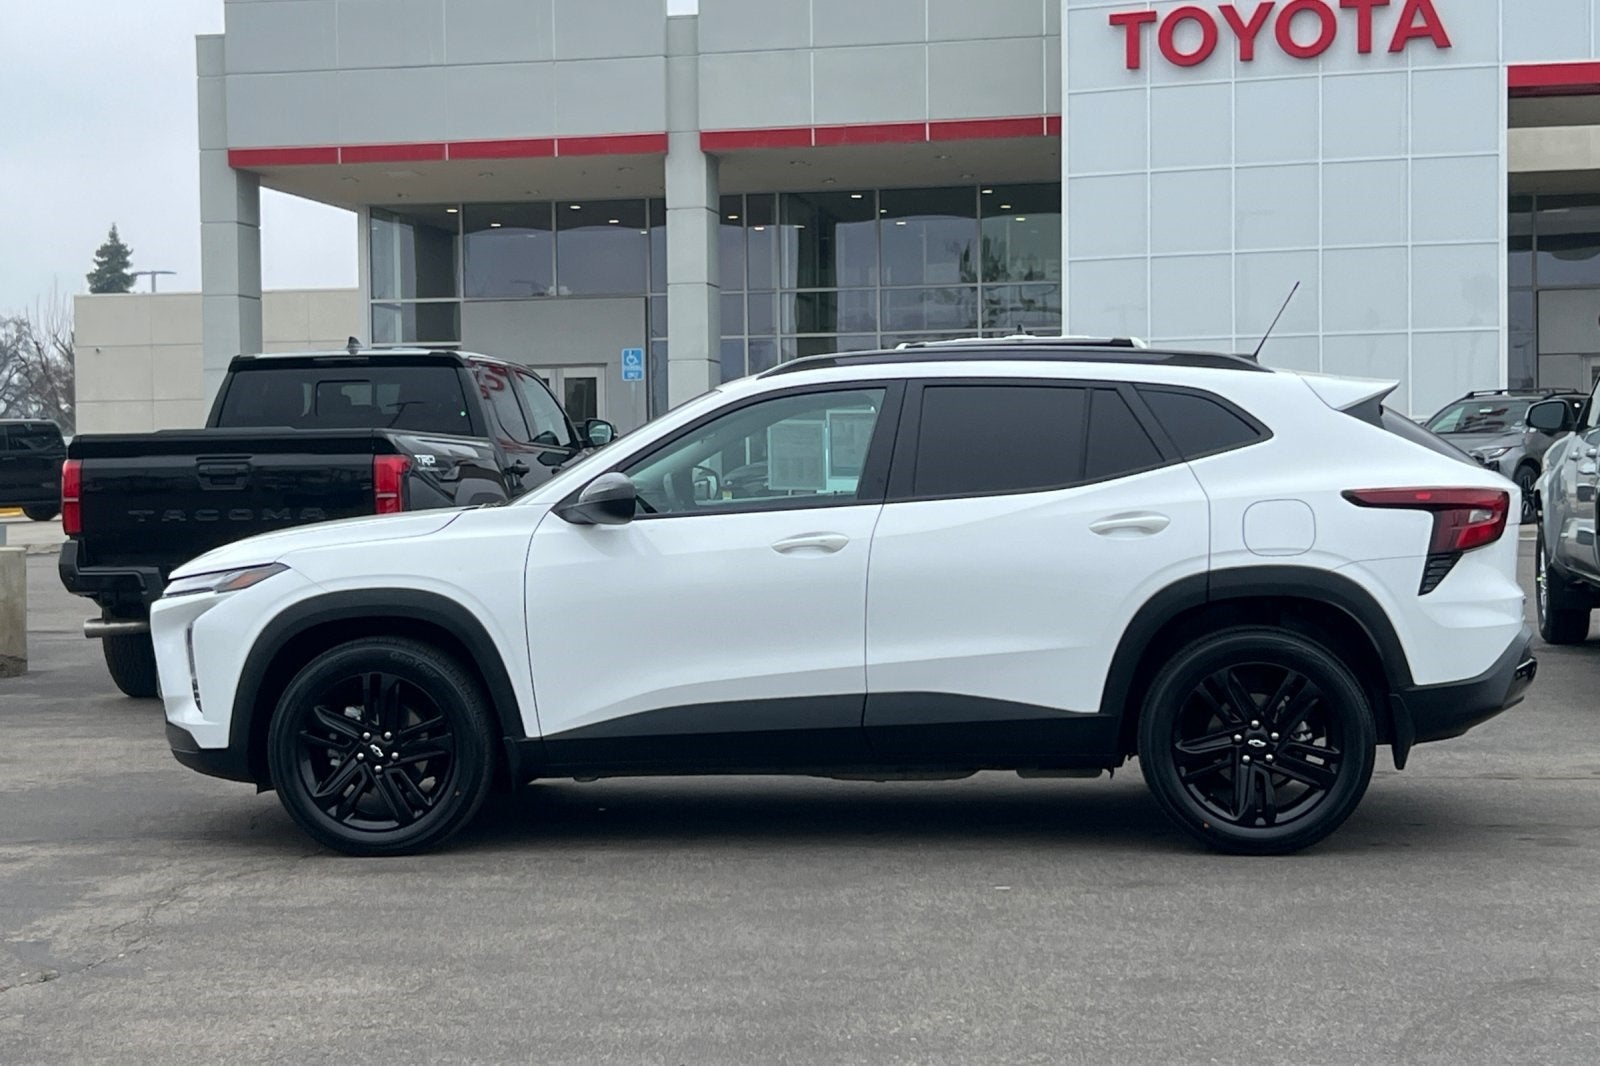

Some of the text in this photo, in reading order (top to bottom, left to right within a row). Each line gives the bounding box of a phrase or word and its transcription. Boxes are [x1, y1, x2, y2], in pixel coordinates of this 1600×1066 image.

[1109, 0, 1452, 70] TOYOTA
[414, 454, 436, 466] TRD
[127, 507, 327, 522] TACOMA
